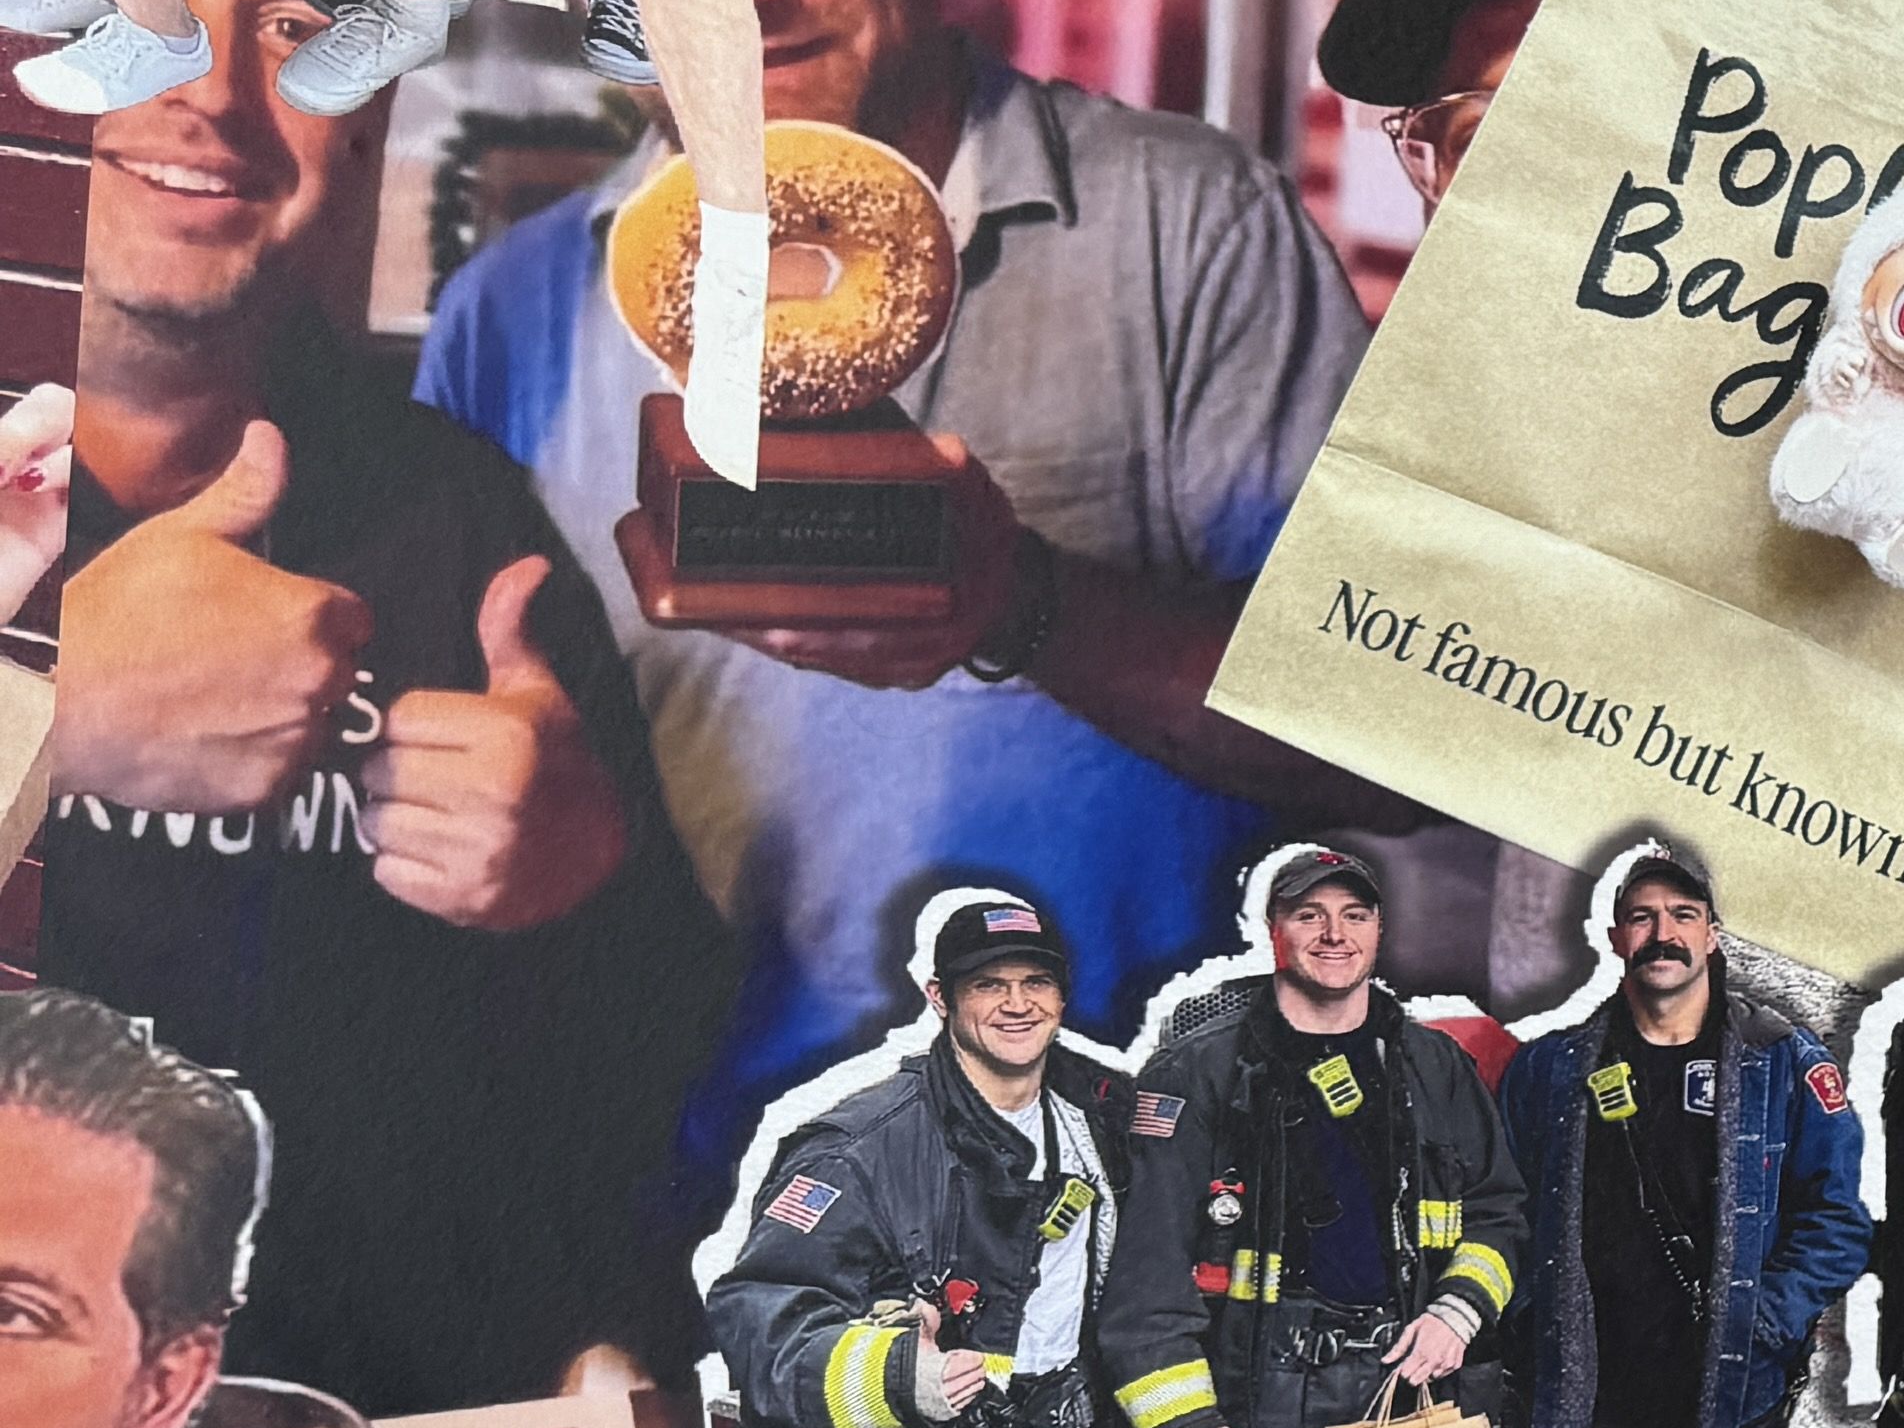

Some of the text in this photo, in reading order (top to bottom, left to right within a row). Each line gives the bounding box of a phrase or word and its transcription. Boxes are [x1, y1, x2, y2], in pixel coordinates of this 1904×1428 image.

[1316, 580, 1418, 664] Not
[1420, 619, 1630, 752] famous
[1633, 701, 1730, 797] but
